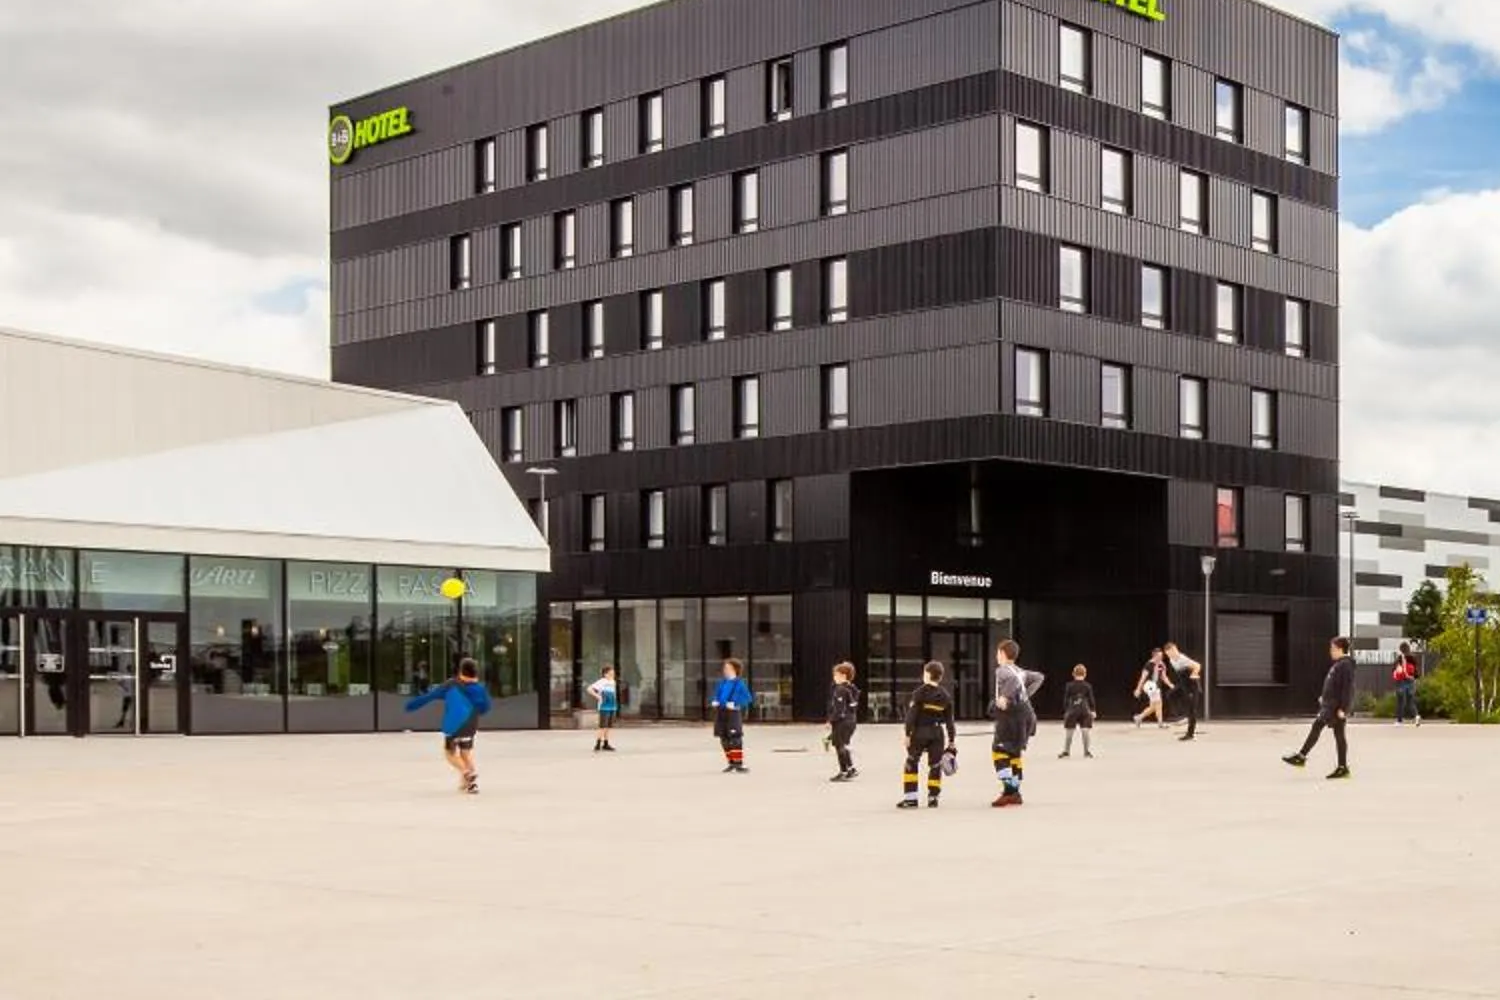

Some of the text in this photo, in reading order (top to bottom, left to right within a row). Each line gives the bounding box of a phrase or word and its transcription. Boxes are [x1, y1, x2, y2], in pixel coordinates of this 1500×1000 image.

[354, 107, 412, 149] HOTEL
[398, 573, 478, 597] PASA
[930, 571, 993, 588] Bienvenue
